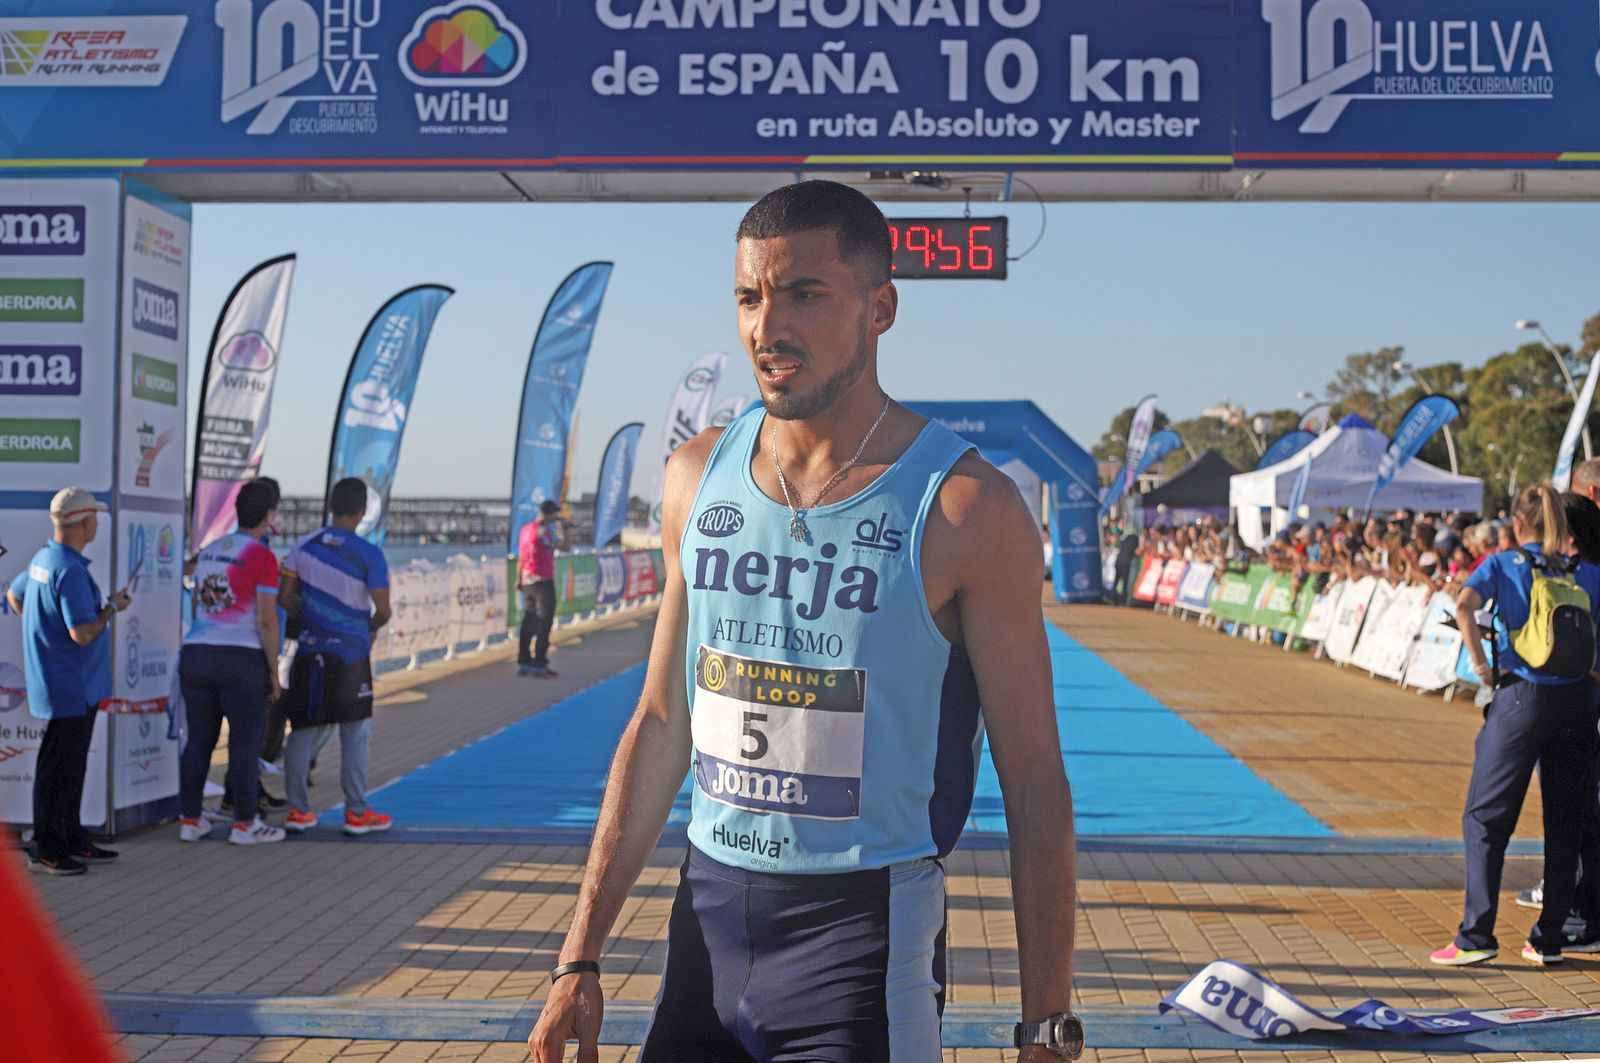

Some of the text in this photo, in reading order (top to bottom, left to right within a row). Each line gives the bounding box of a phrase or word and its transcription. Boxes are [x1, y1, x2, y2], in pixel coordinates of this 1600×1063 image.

[44, 48, 160, 61] ATLETISMO
[1373, 20, 1554, 73] HUELVA
[36, 63, 161, 76] RUTA RUNNING
[590, 34, 1200, 104] de ESPAÑA 10 km
[1373, 77, 1554, 94] PUERTA DEL DESCUBRIMIENTO
[319, 102, 376, 118] PUERTA DEL
[414, 90, 509, 122] WiHu
[289, 118, 378, 134] DESCUBRIMIENTO
[756, 107, 1200, 145] en ruta Absoluto y Master
[0, 212, 80, 245] ma
[0, 353, 77, 385] ma
[223, 373, 265, 392] WiHu
[698, 507, 742, 532] TROPS
[692, 542, 879, 621] nerja
[711, 617, 843, 658] ATLETISMO
[735, 662, 837, 688] RUNNING
[756, 686, 817, 706] LOOP
[740, 711, 769, 761] 5
[712, 762, 809, 806] Joma
[712, 821, 785, 859] Huelva
[750, 857, 779, 870] original
